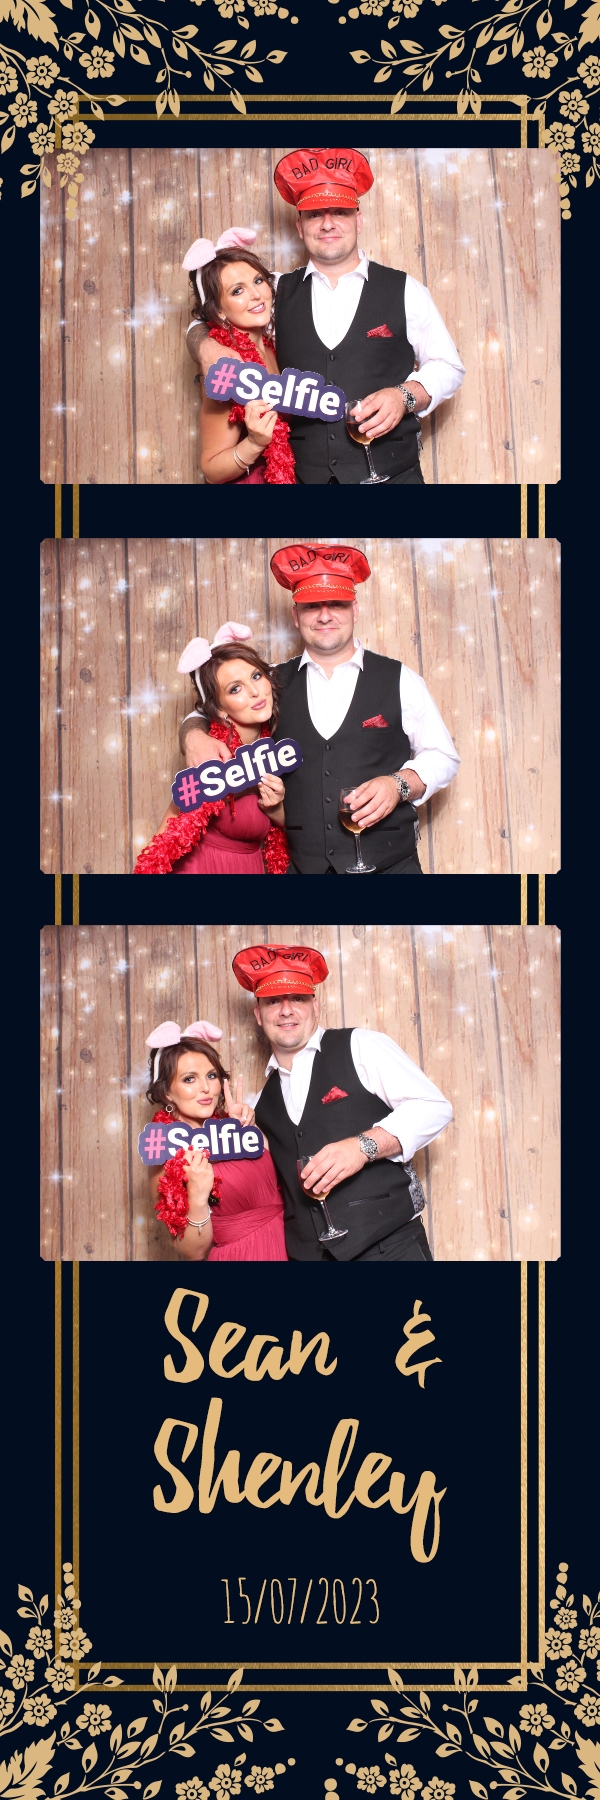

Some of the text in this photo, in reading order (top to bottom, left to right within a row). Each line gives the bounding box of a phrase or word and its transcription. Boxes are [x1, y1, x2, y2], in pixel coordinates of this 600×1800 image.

[291, 158, 353, 180] BAD GIRL
[211, 363, 341, 416] #Selfie
[288, 550, 350, 572] BAD GIRL
[178, 744, 298, 807] #Selfie
[249, 950, 309, 971] BAD GIRL
[144, 1123, 260, 1160] #Selfie
